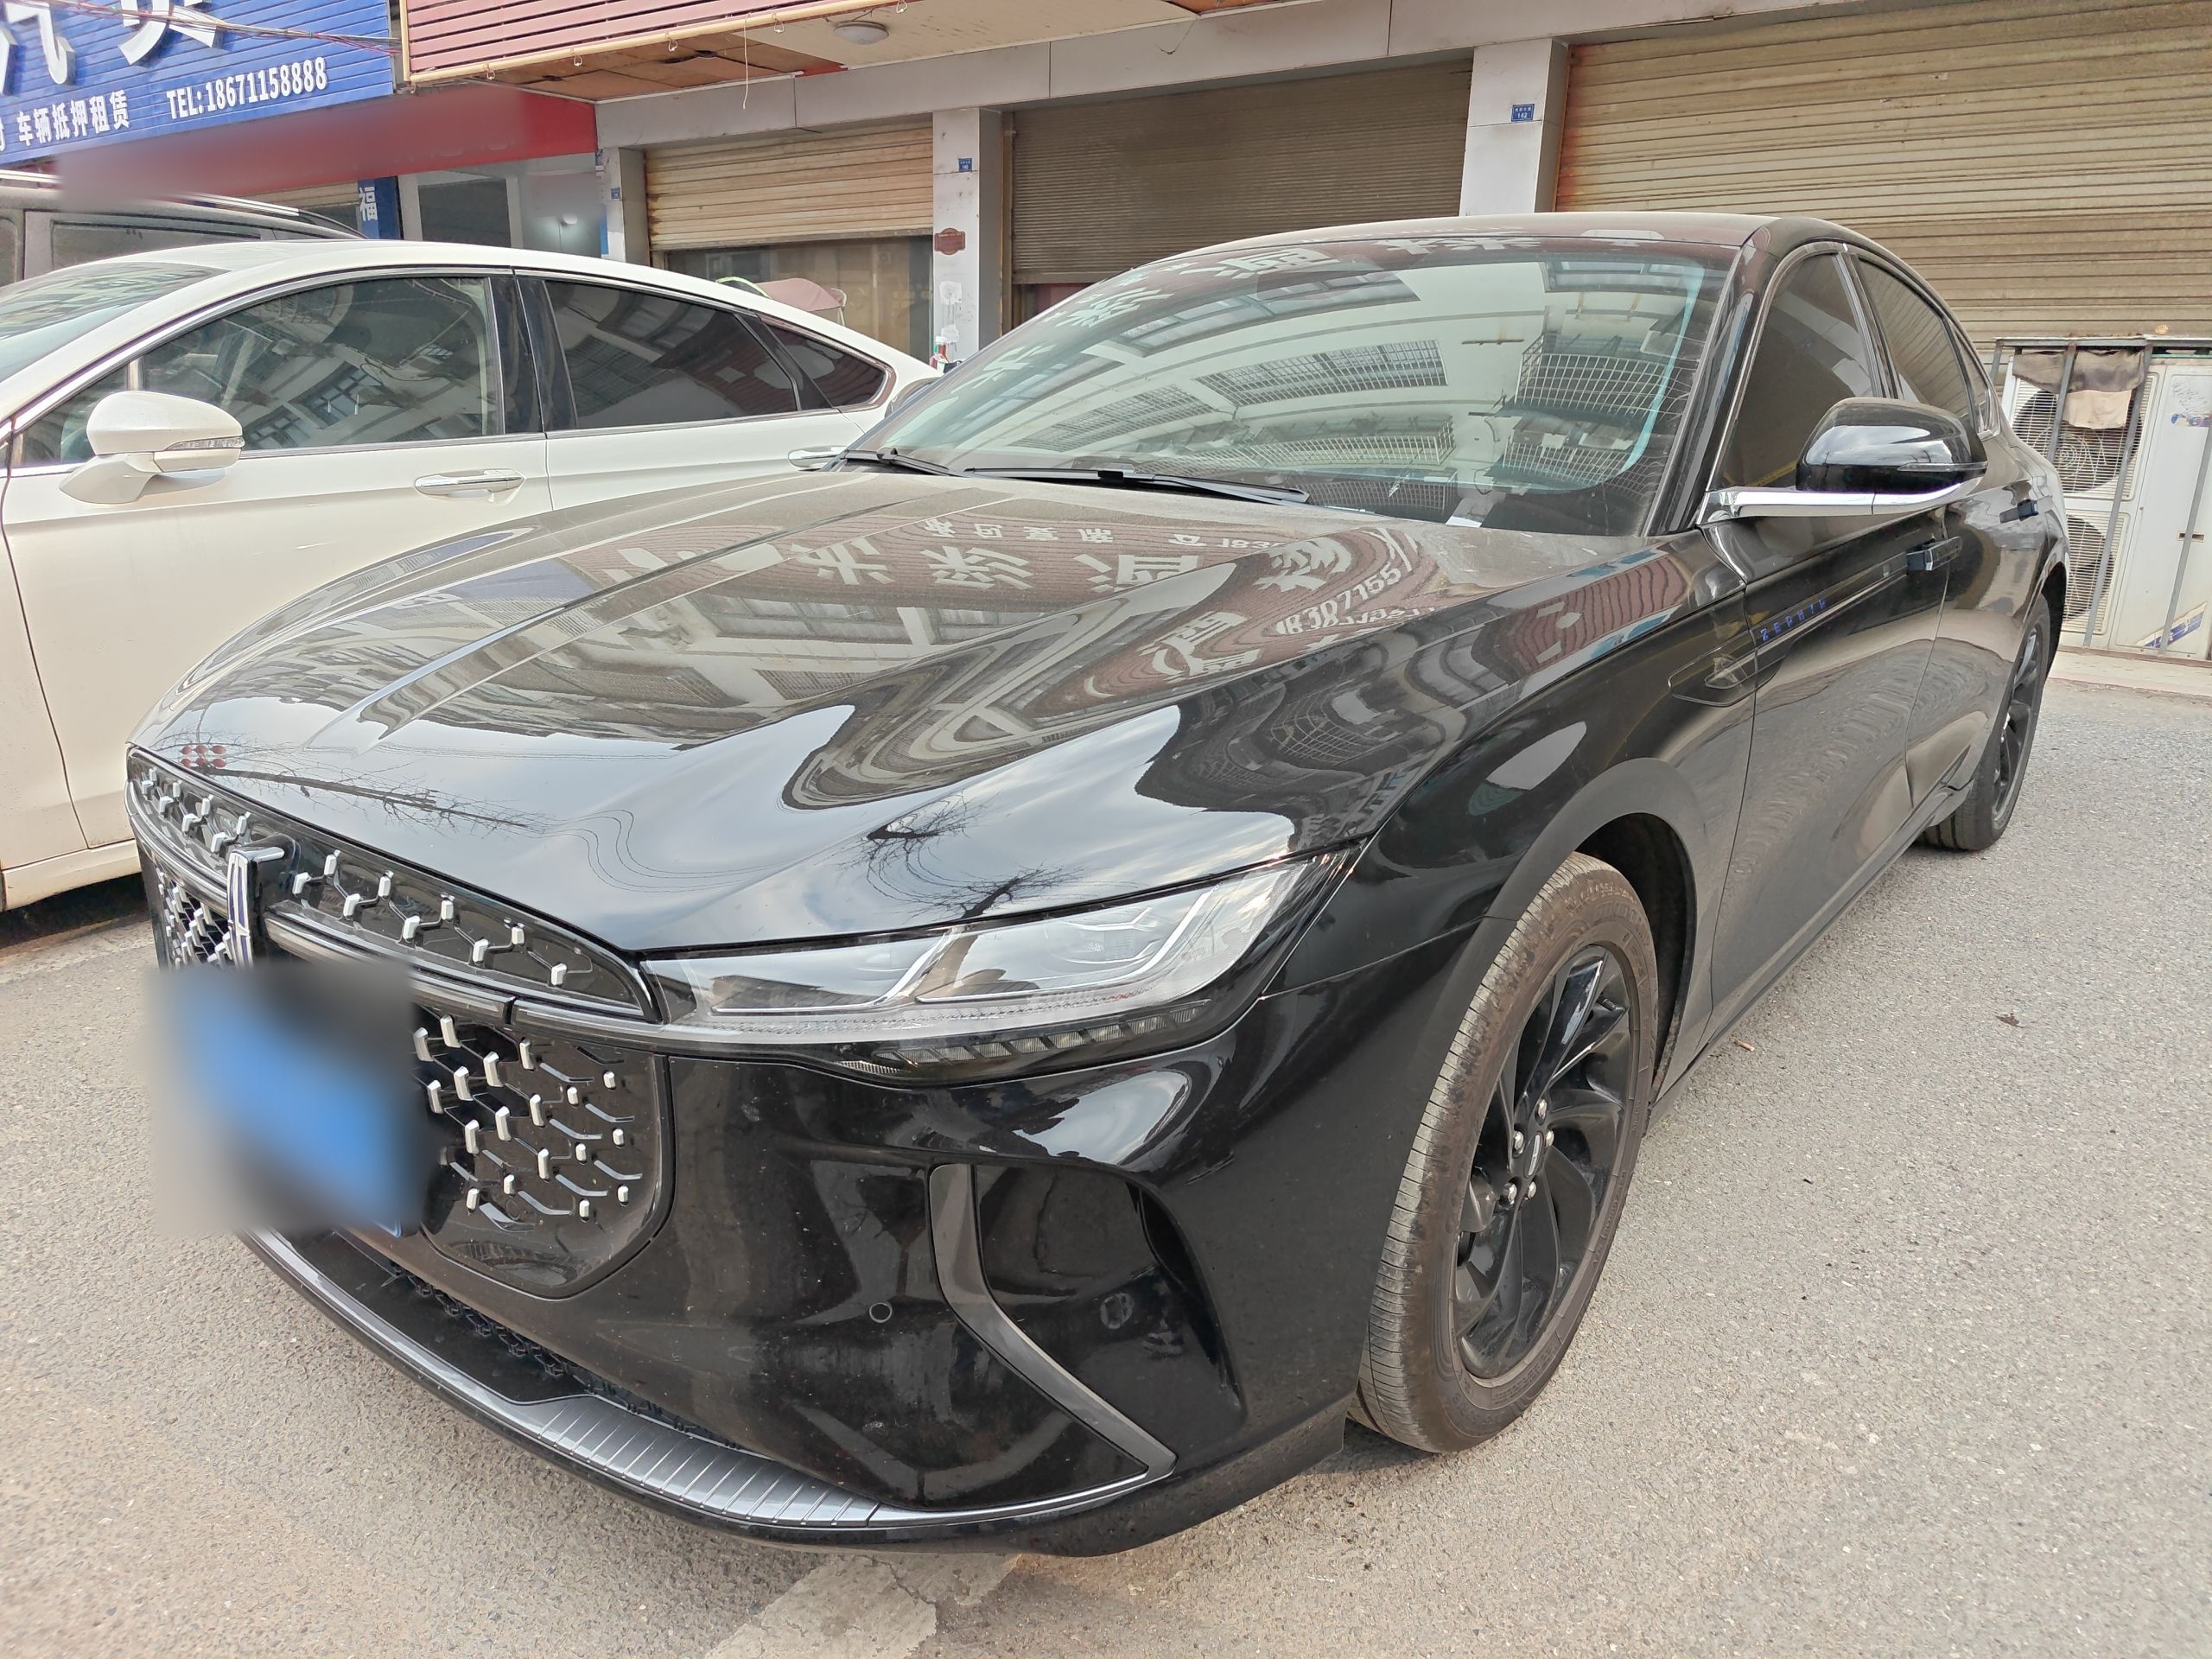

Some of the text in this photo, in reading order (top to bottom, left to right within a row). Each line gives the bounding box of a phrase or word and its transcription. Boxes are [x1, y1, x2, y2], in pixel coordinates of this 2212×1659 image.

[167, 57, 327, 119] TEL:18671158888
[16, 89, 130, 146] 车辆抵押租赁
[359, 186, 378, 222] 福
